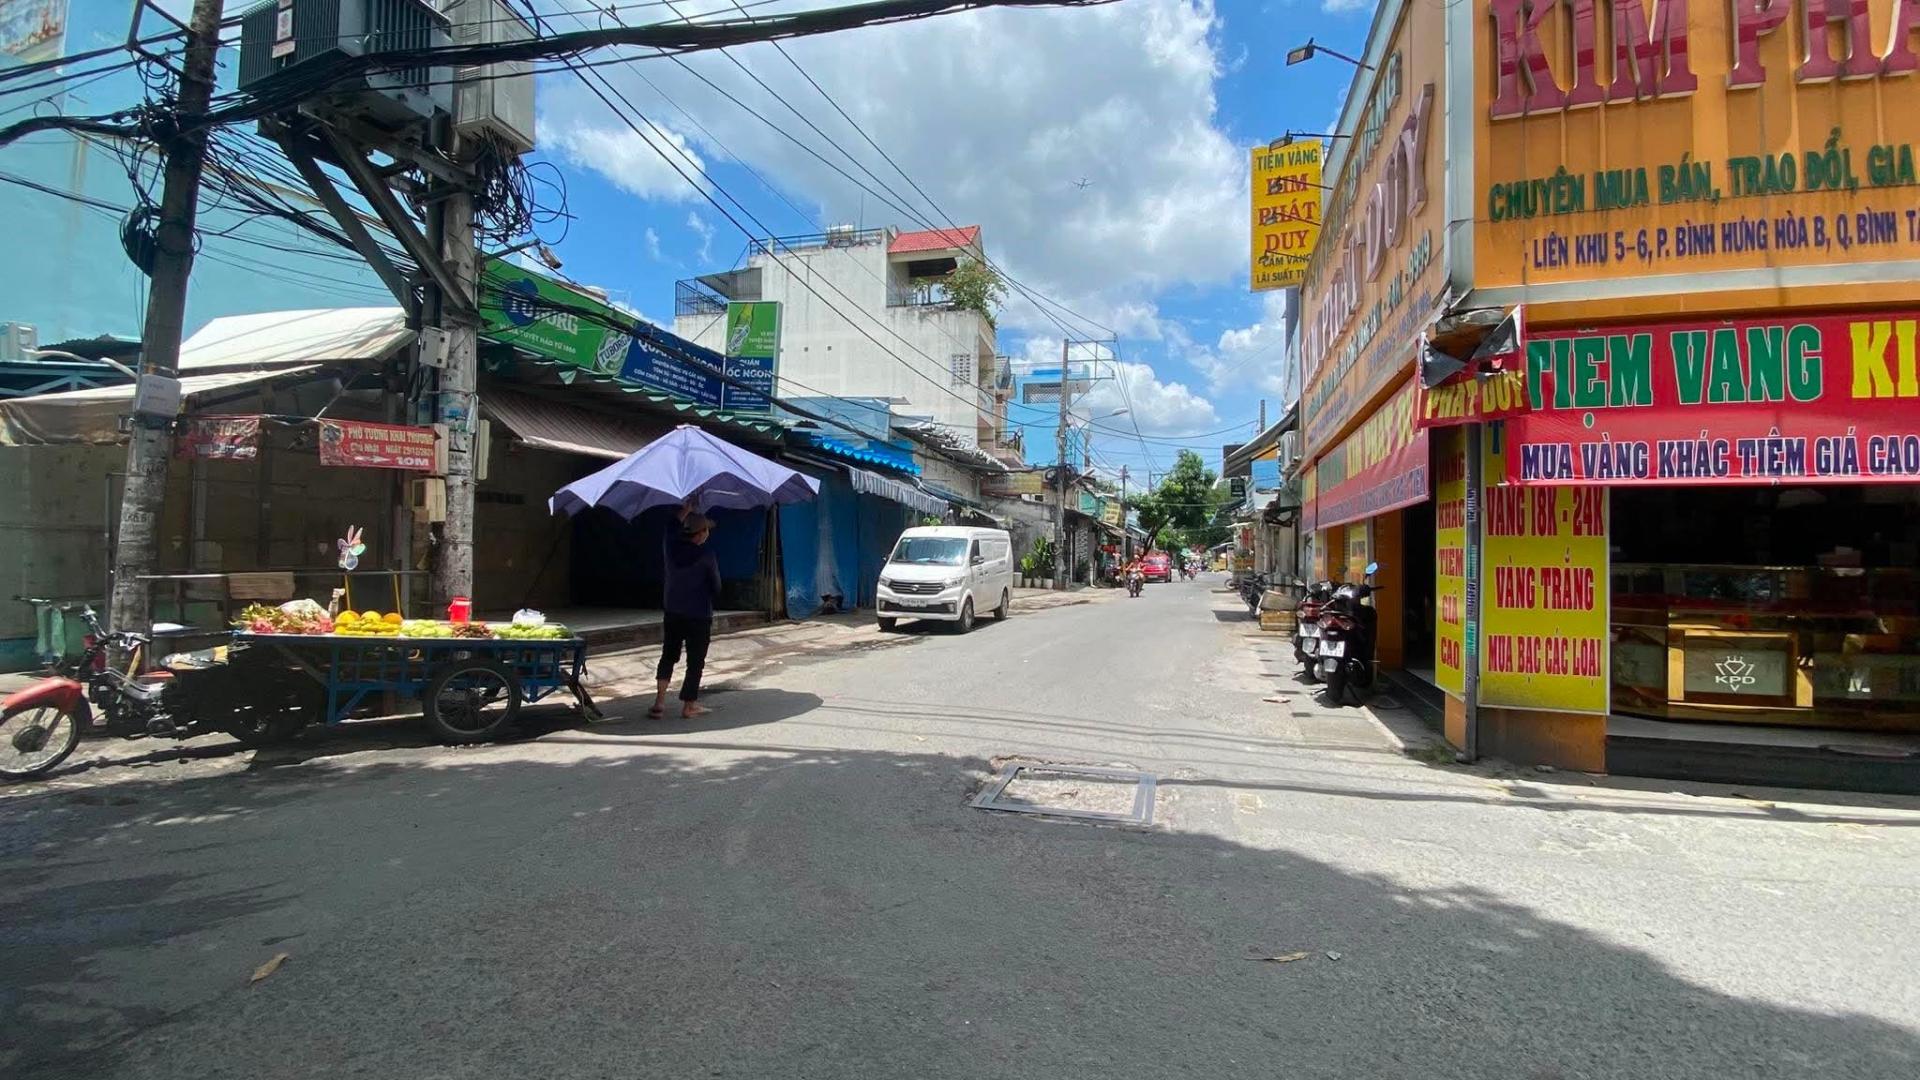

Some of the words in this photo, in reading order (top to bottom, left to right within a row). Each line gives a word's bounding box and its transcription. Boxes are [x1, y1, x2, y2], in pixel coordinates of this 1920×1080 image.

[1491, 0, 1698, 120] KIM
[1257, 153, 1285, 173] TIỆM
[1288, 147, 1318, 167] VÀNG
[1266, 173, 1309, 196] KIM
[1365, 83, 1435, 283] DUY
[1488, 165, 1585, 223] CHUYÊN
[1594, 167, 1649, 210] MUA
[1658, 151, 1720, 207] BÁN,
[1728, 152, 1797, 197] TRAO
[1867, 143, 1916, 186] GIA
[1258, 198, 1317, 226] PHÁT
[1265, 229, 1309, 252] DUY
[1534, 231, 1569, 268] LIÊN
[1576, 231, 1609, 265] KHU
[1615, 228, 1653, 267] 5-6,
[1657, 228, 1671, 258] P.
[1676, 219, 1716, 257] BÌNH
[1775, 210, 1809, 250] HÒA
[1814, 215, 1831, 254] B,
[1836, 213, 1853, 250] Q.
[1857, 206, 1898, 245] BÌNH
[1906, 208, 1920, 243] T
[1272, 267, 1294, 282] SUẤT
[743, 370, 771, 379] NGON
[1520, 442, 1574, 481] MUA
[1580, 432, 1649, 481] VÀNG
[1656, 429, 1730, 479] KHÁC
[1814, 426, 1859, 477] GIÁ
[1867, 434, 1920, 476] CAO
[1531, 486, 1557, 537] 18K
[1573, 486, 1604, 537] 24K
[1495, 555, 1536, 609] VÀNG
[1541, 547, 1594, 611] TRẮNG
[1440, 636, 1460, 670] CAO
[1488, 635, 1513, 673] MUA
[1518, 636, 1541, 683] BẠC
[1545, 627, 1568, 676] CÁC
[1715, 675, 1755, 685] KPD
